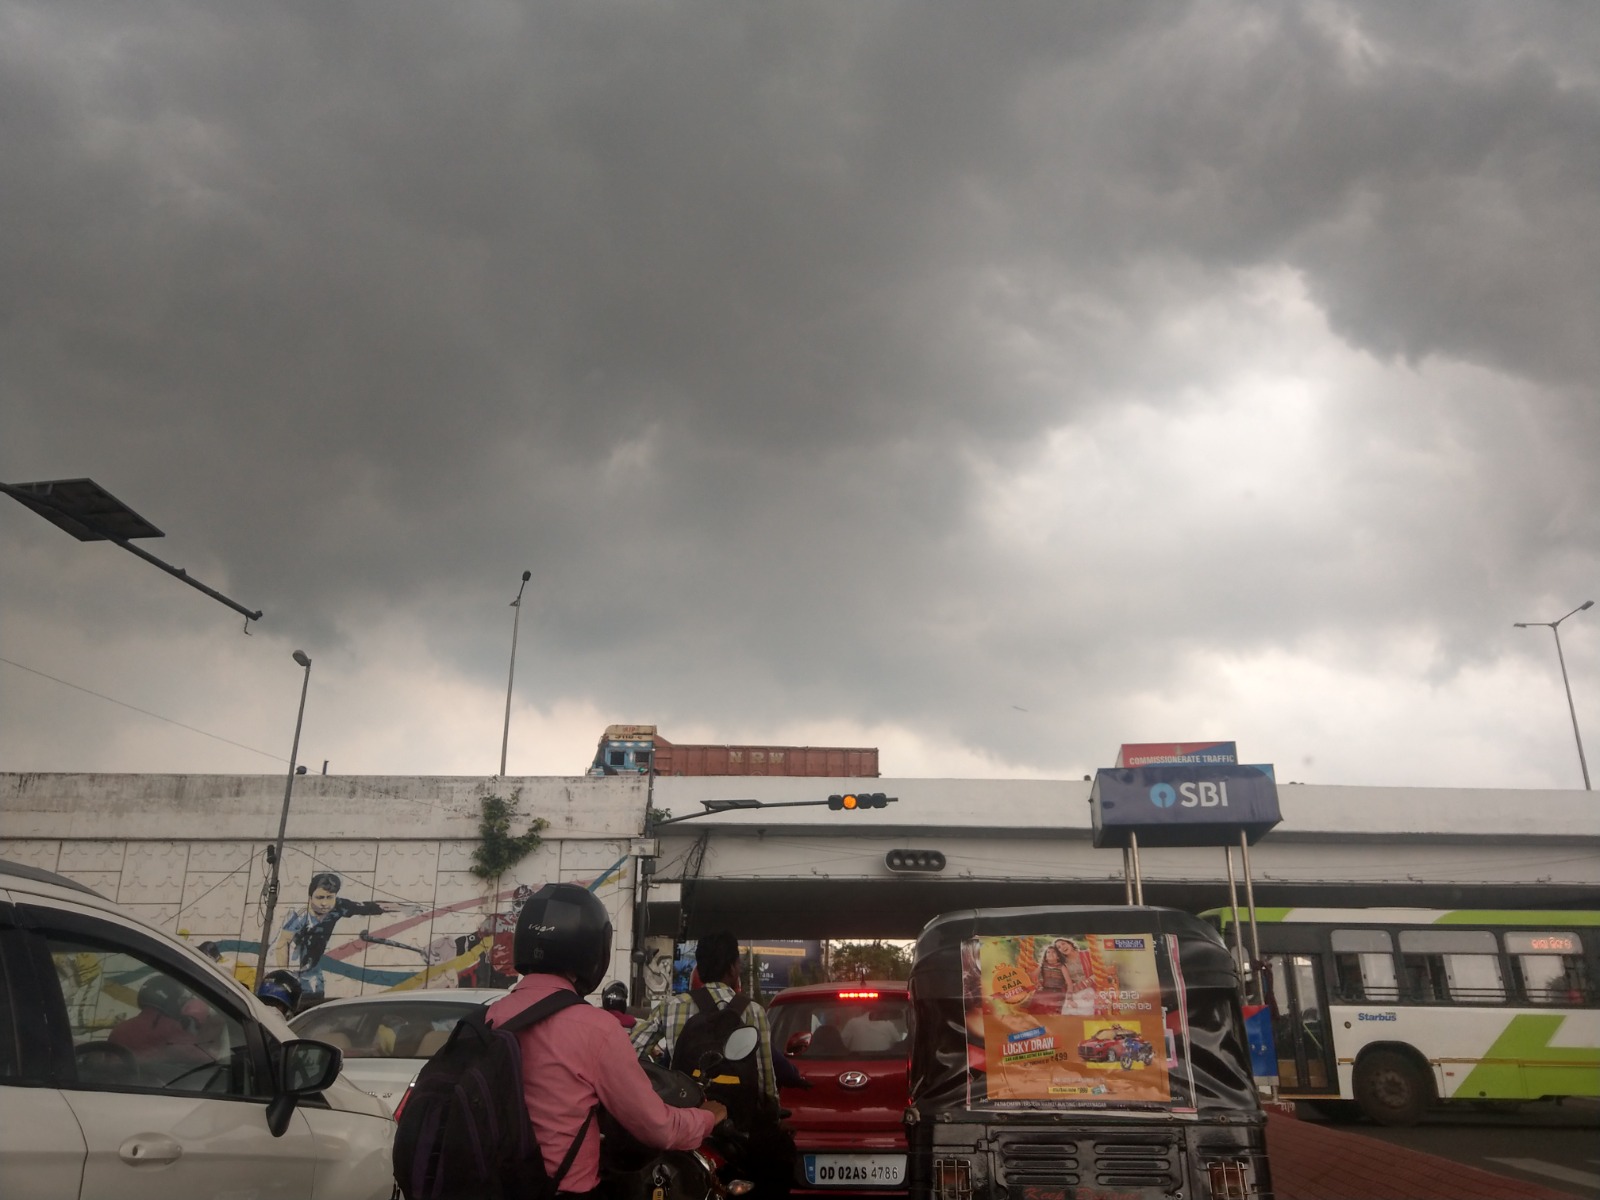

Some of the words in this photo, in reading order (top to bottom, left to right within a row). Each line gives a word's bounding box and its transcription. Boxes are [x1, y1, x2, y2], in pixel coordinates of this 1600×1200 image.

[1129, 755, 1201, 766] COMMISSIONERATE
[1202, 754, 1235, 764] TRAFFIC
[1180, 782, 1228, 808] SBI
[997, 970, 1018, 982] RAJA
[1002, 979, 1022, 991] SAJA
[1004, 986, 1024, 999] OFFER
[1358, 1012, 1397, 1021] Starbus
[1002, 1040, 1030, 1056] LUCKY
[1030, 1036, 1054, 1051] DRAW
[820, 1166, 835, 1180] OD
[838, 1166, 867, 1180] 02AS
[871, 1166, 898, 1180] 4786
